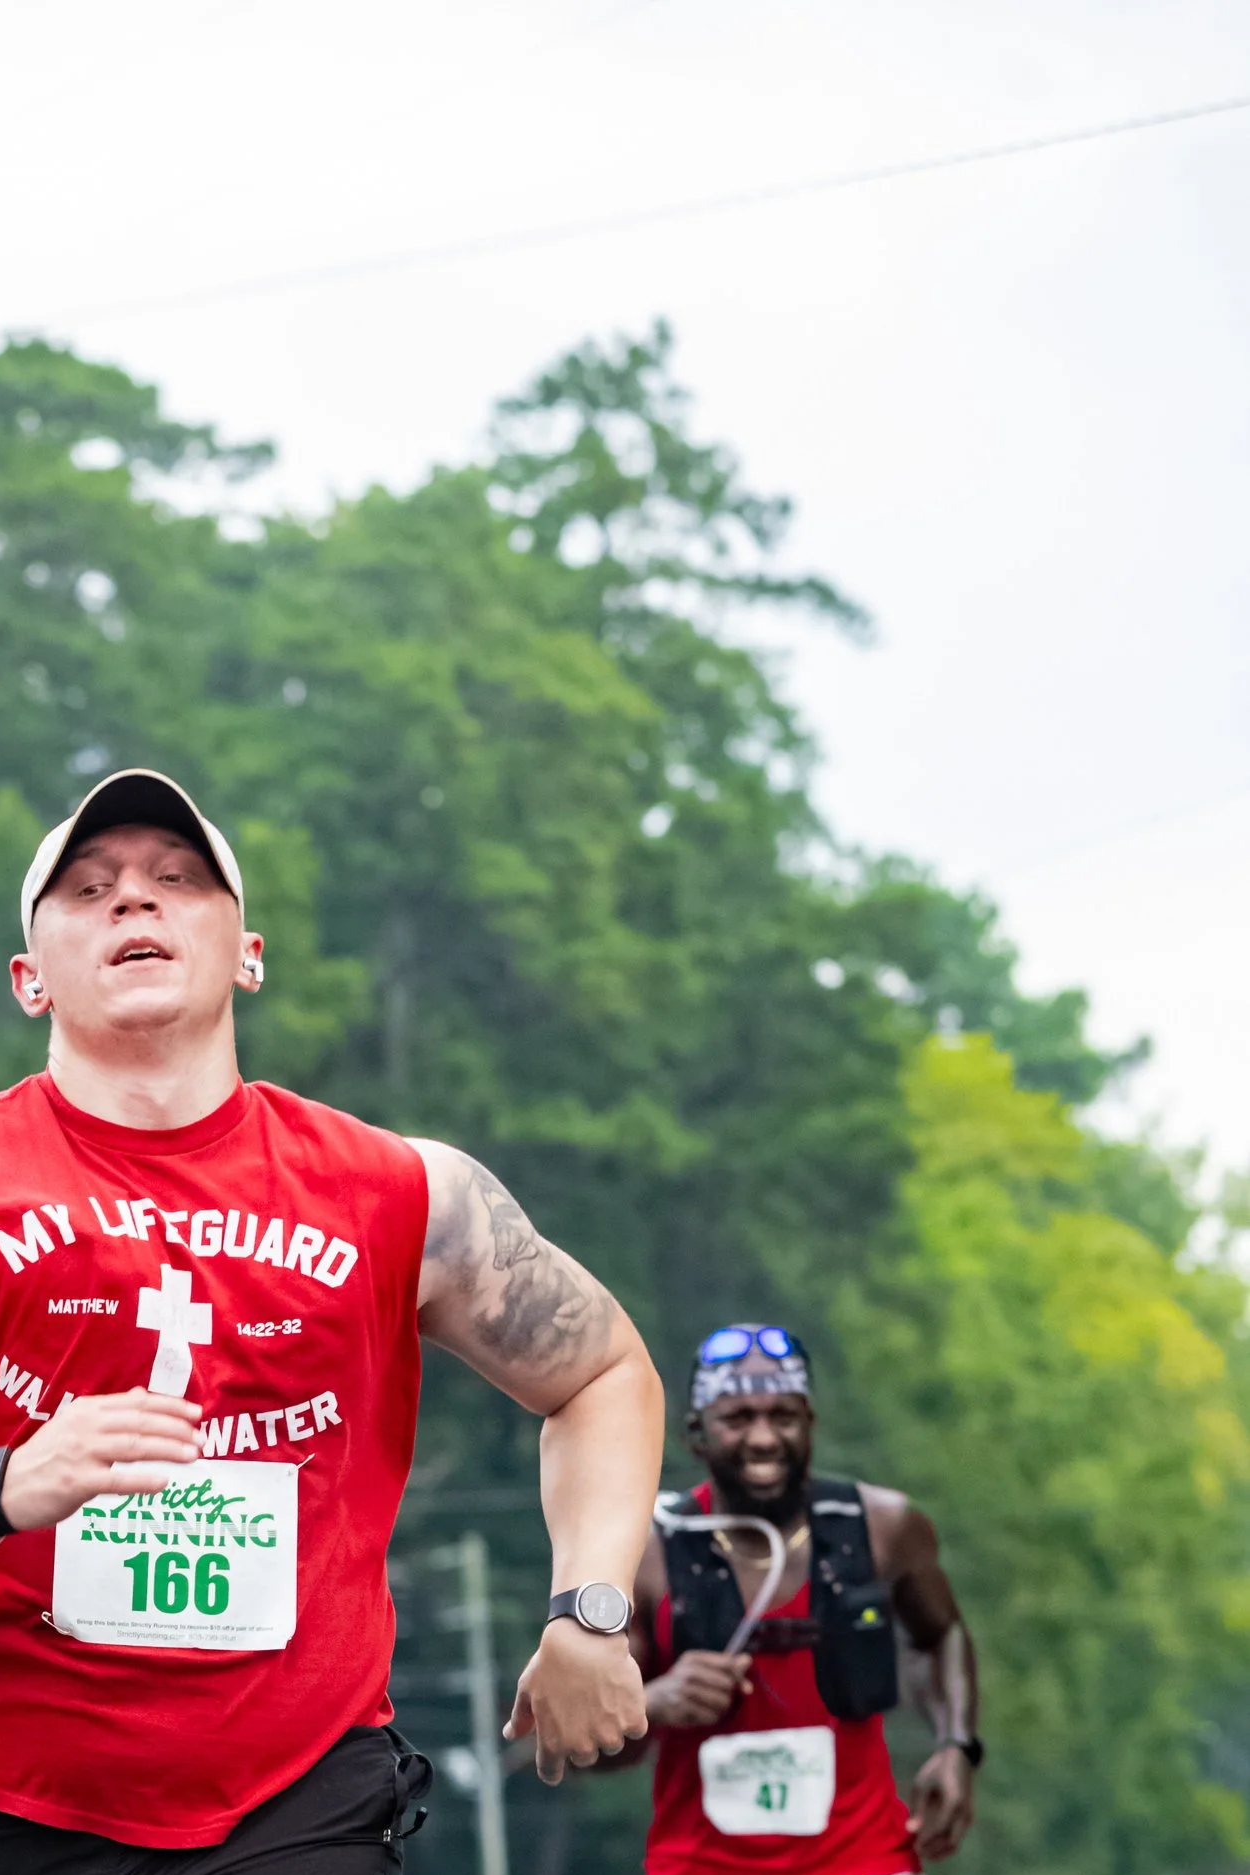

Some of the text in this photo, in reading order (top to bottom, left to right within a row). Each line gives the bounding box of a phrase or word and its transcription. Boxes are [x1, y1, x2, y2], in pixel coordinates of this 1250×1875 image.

[88, 1196, 359, 1289] LIFEGUARD
[47, 1298, 302, 1337] MATTHEW 14:22-32
[200, 1390, 343, 1458] WATER
[80, 1506, 277, 1548] RUNNING
[123, 1551, 231, 1616] 166
